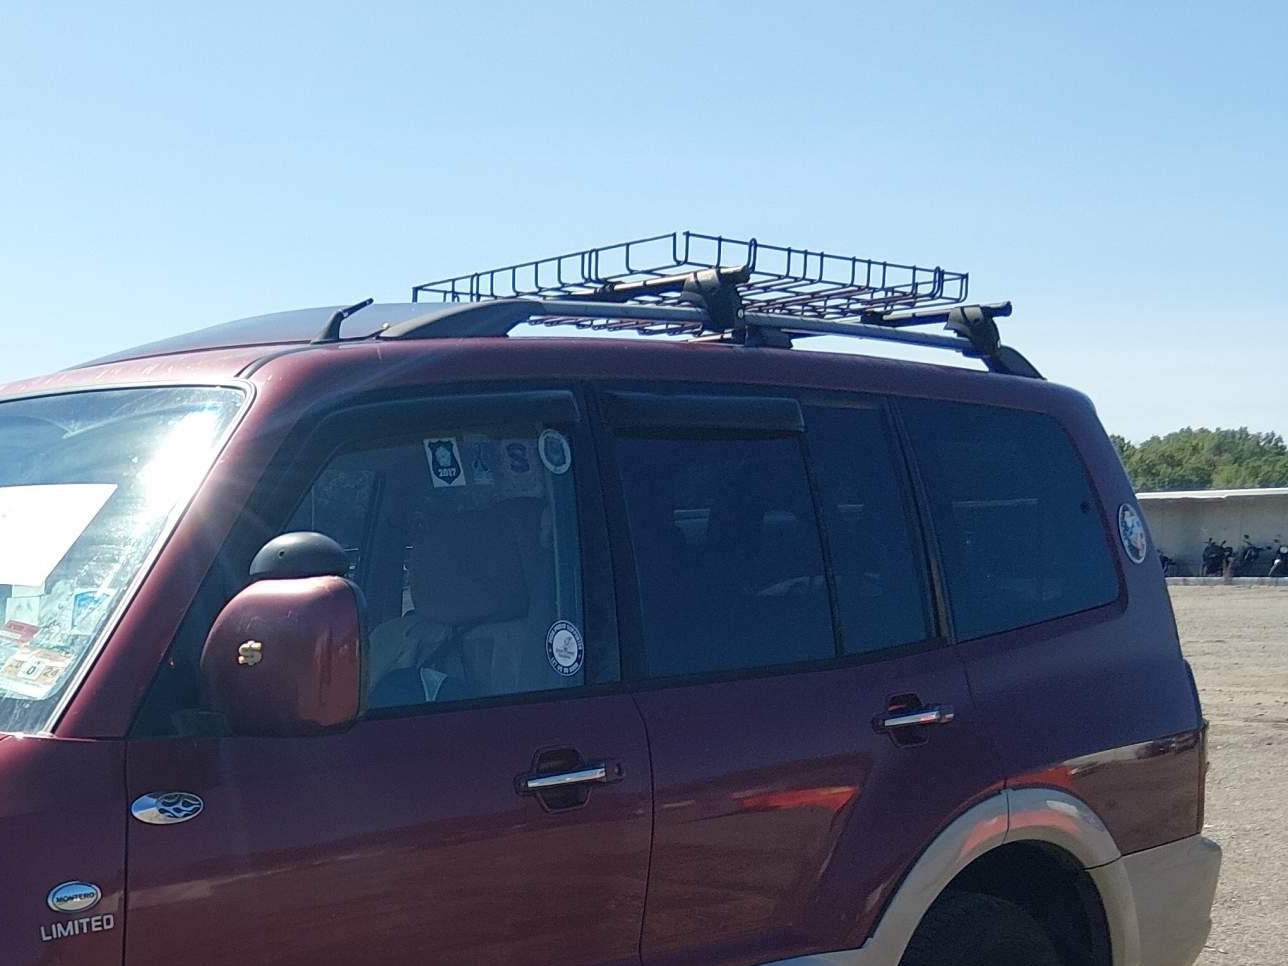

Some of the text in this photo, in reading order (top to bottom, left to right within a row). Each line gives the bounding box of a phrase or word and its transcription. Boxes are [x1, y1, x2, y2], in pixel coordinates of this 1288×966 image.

[438, 467, 456, 477] 2017
[55, 892, 95, 903] MONTERO
[40, 914, 115, 941] LIMITED
